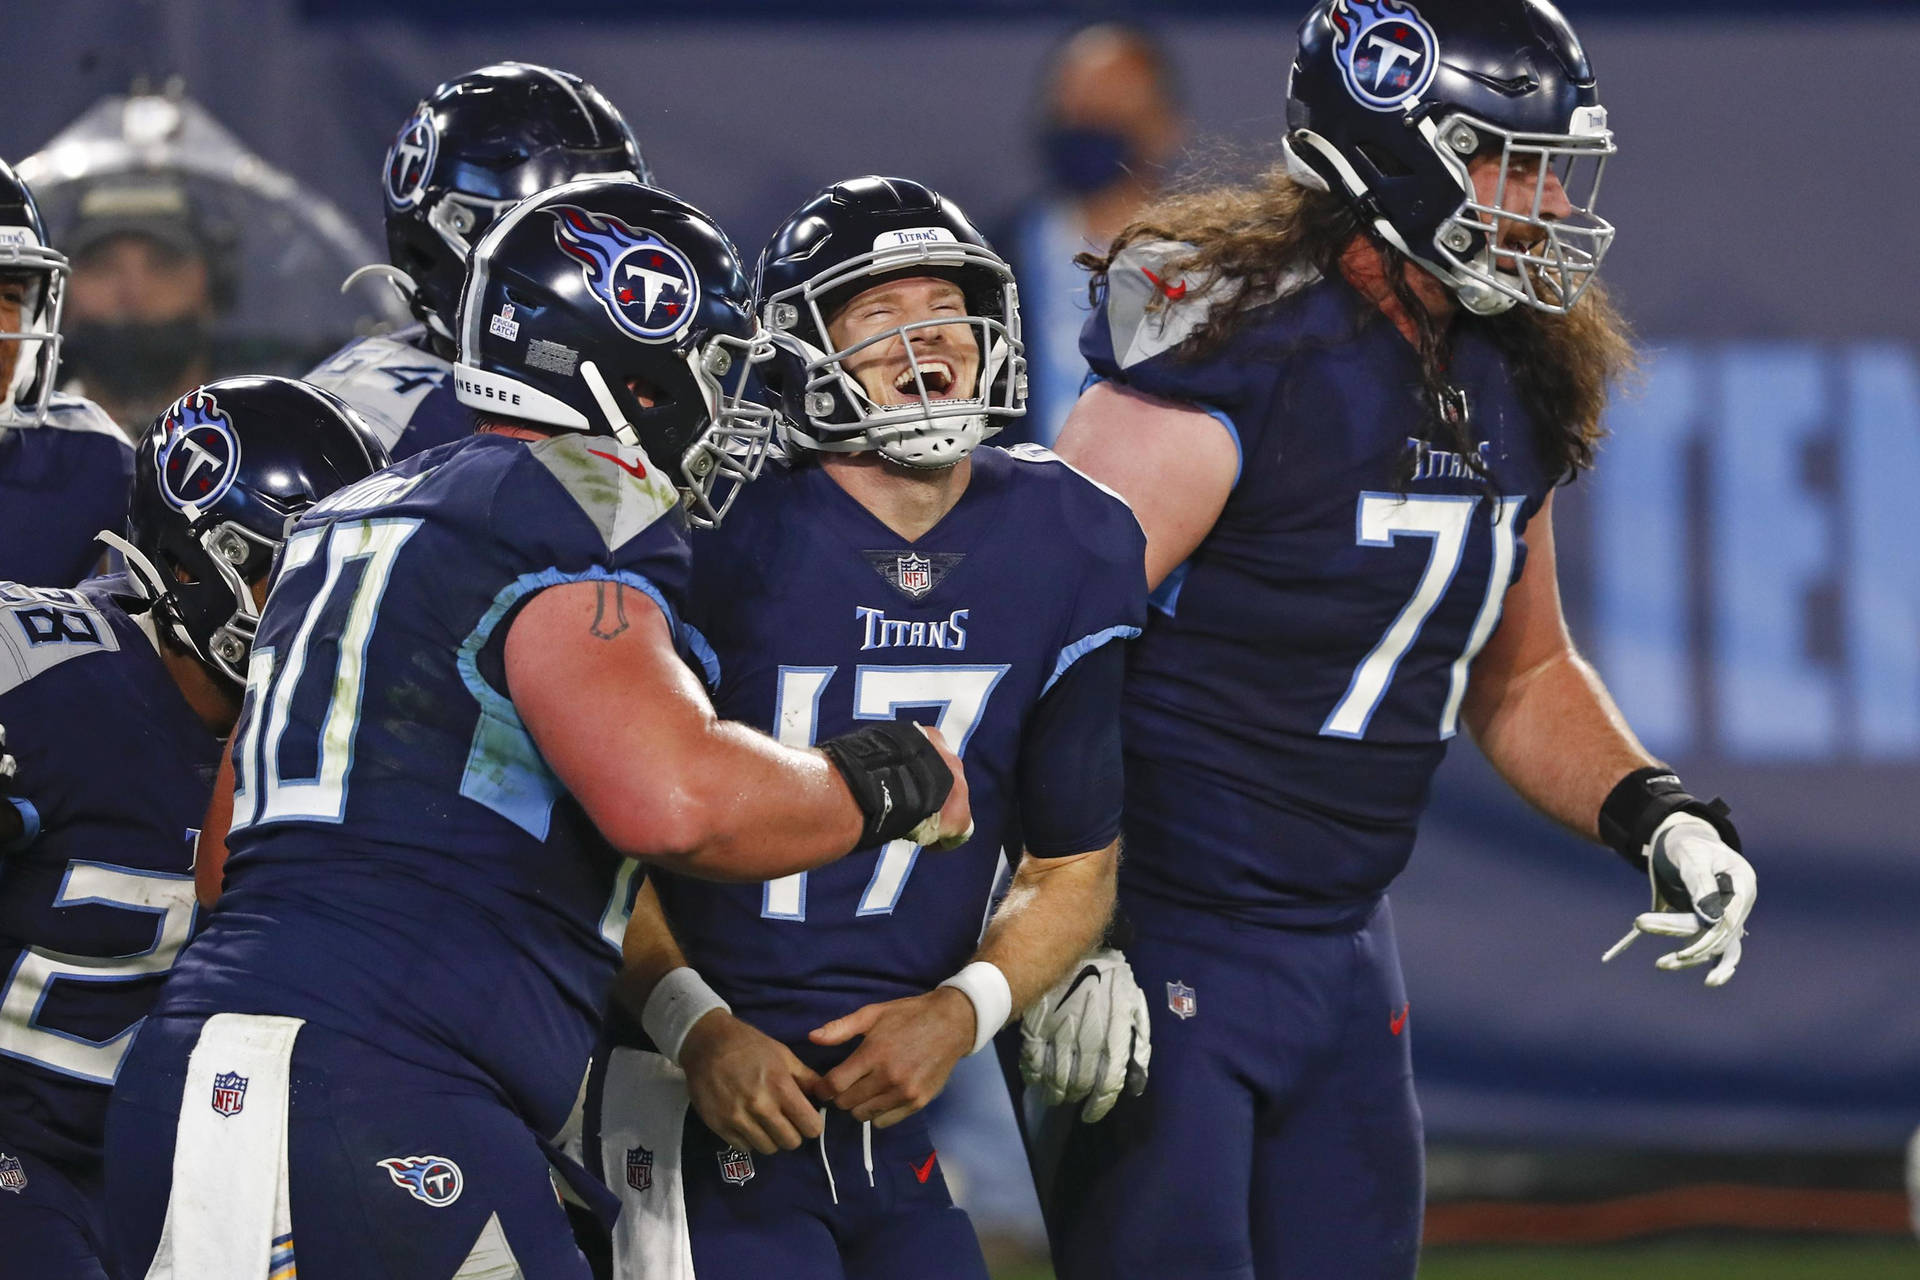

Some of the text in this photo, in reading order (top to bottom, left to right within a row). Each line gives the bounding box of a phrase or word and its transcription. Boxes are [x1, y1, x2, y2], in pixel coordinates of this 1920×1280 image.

[893, 229, 938, 244] TITANS
[491, 322, 516, 337] CATCH
[904, 572, 926, 587] NFL
[1319, 490, 1528, 741] 71
[856, 606, 970, 651] TITANS
[761, 664, 1012, 922] 17
[214, 1089, 241, 1112] NFL
[629, 1166, 651, 1187] NFL
[726, 1162, 750, 1178] NFL
